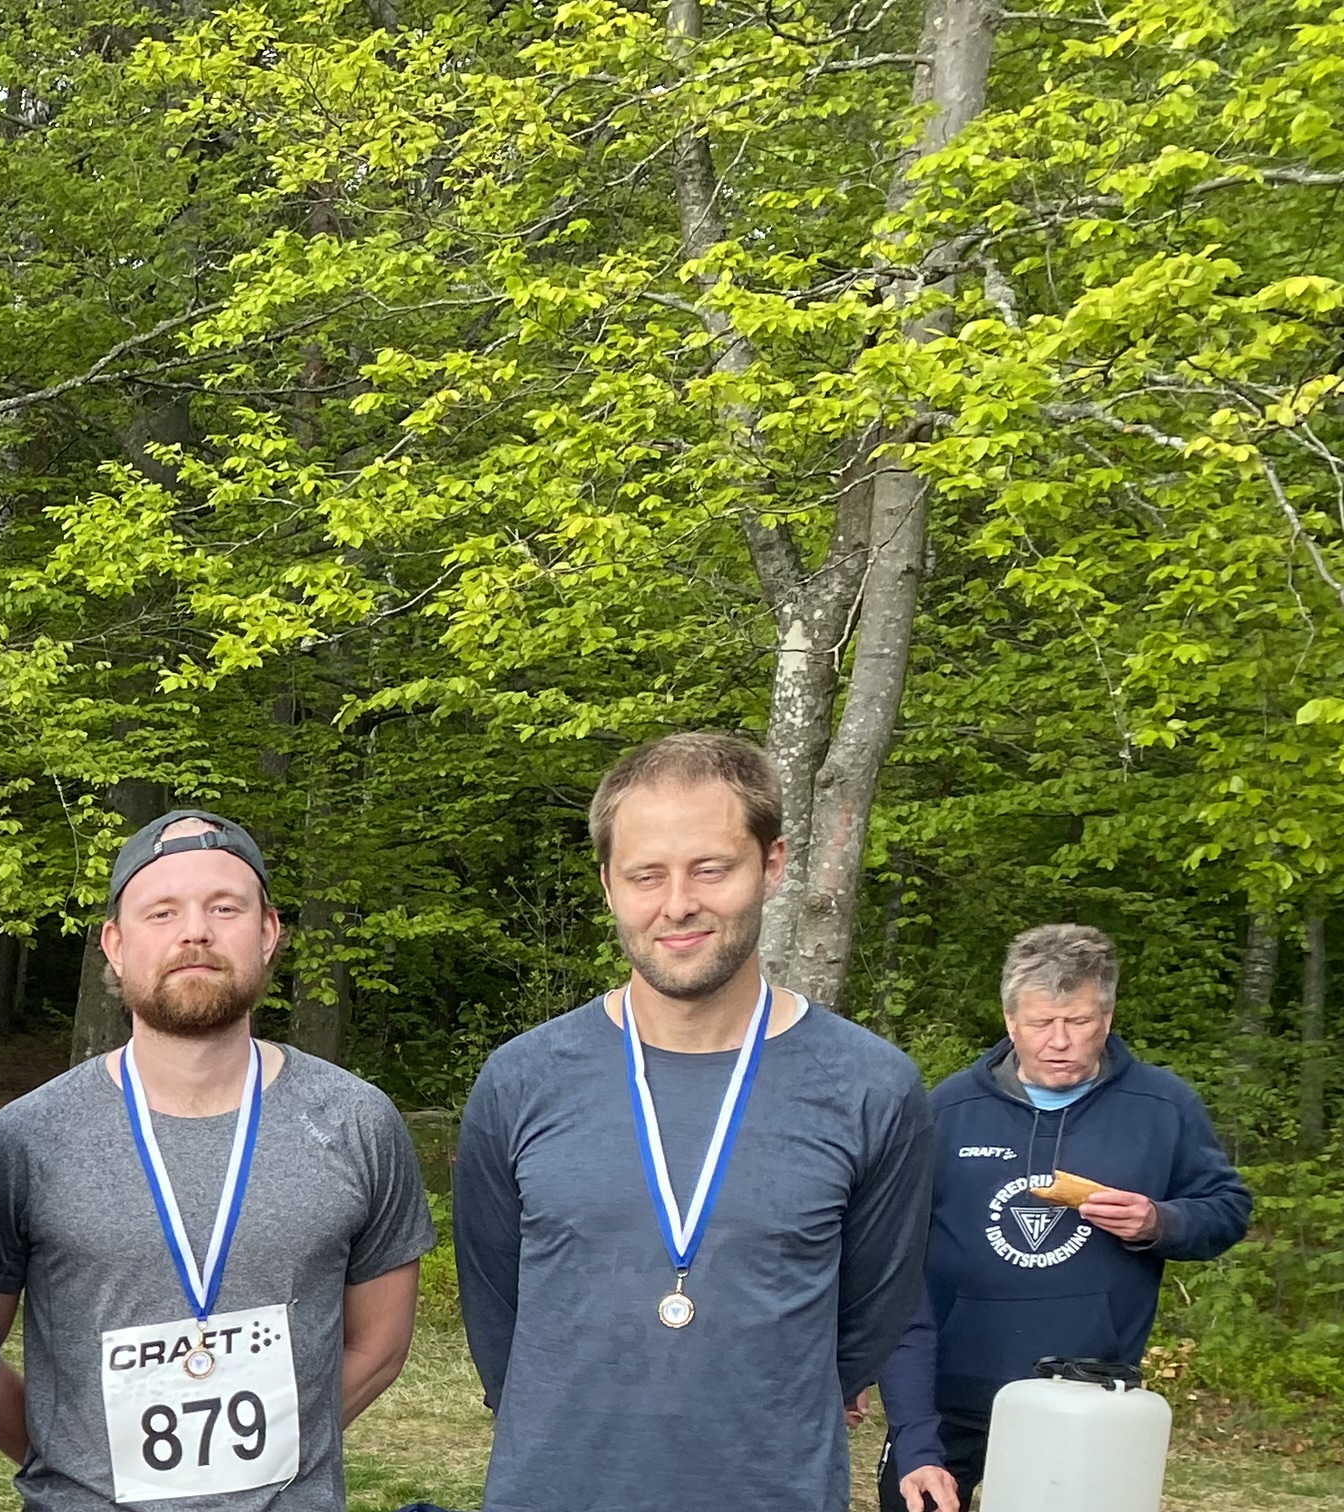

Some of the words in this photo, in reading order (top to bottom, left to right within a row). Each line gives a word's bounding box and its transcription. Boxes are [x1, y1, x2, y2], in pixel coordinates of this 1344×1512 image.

[958, 1146, 1005, 1158] CRAFT
[985, 1225, 1092, 1268] IDRETTSFORENING
[141, 1389, 267, 1471] 879
